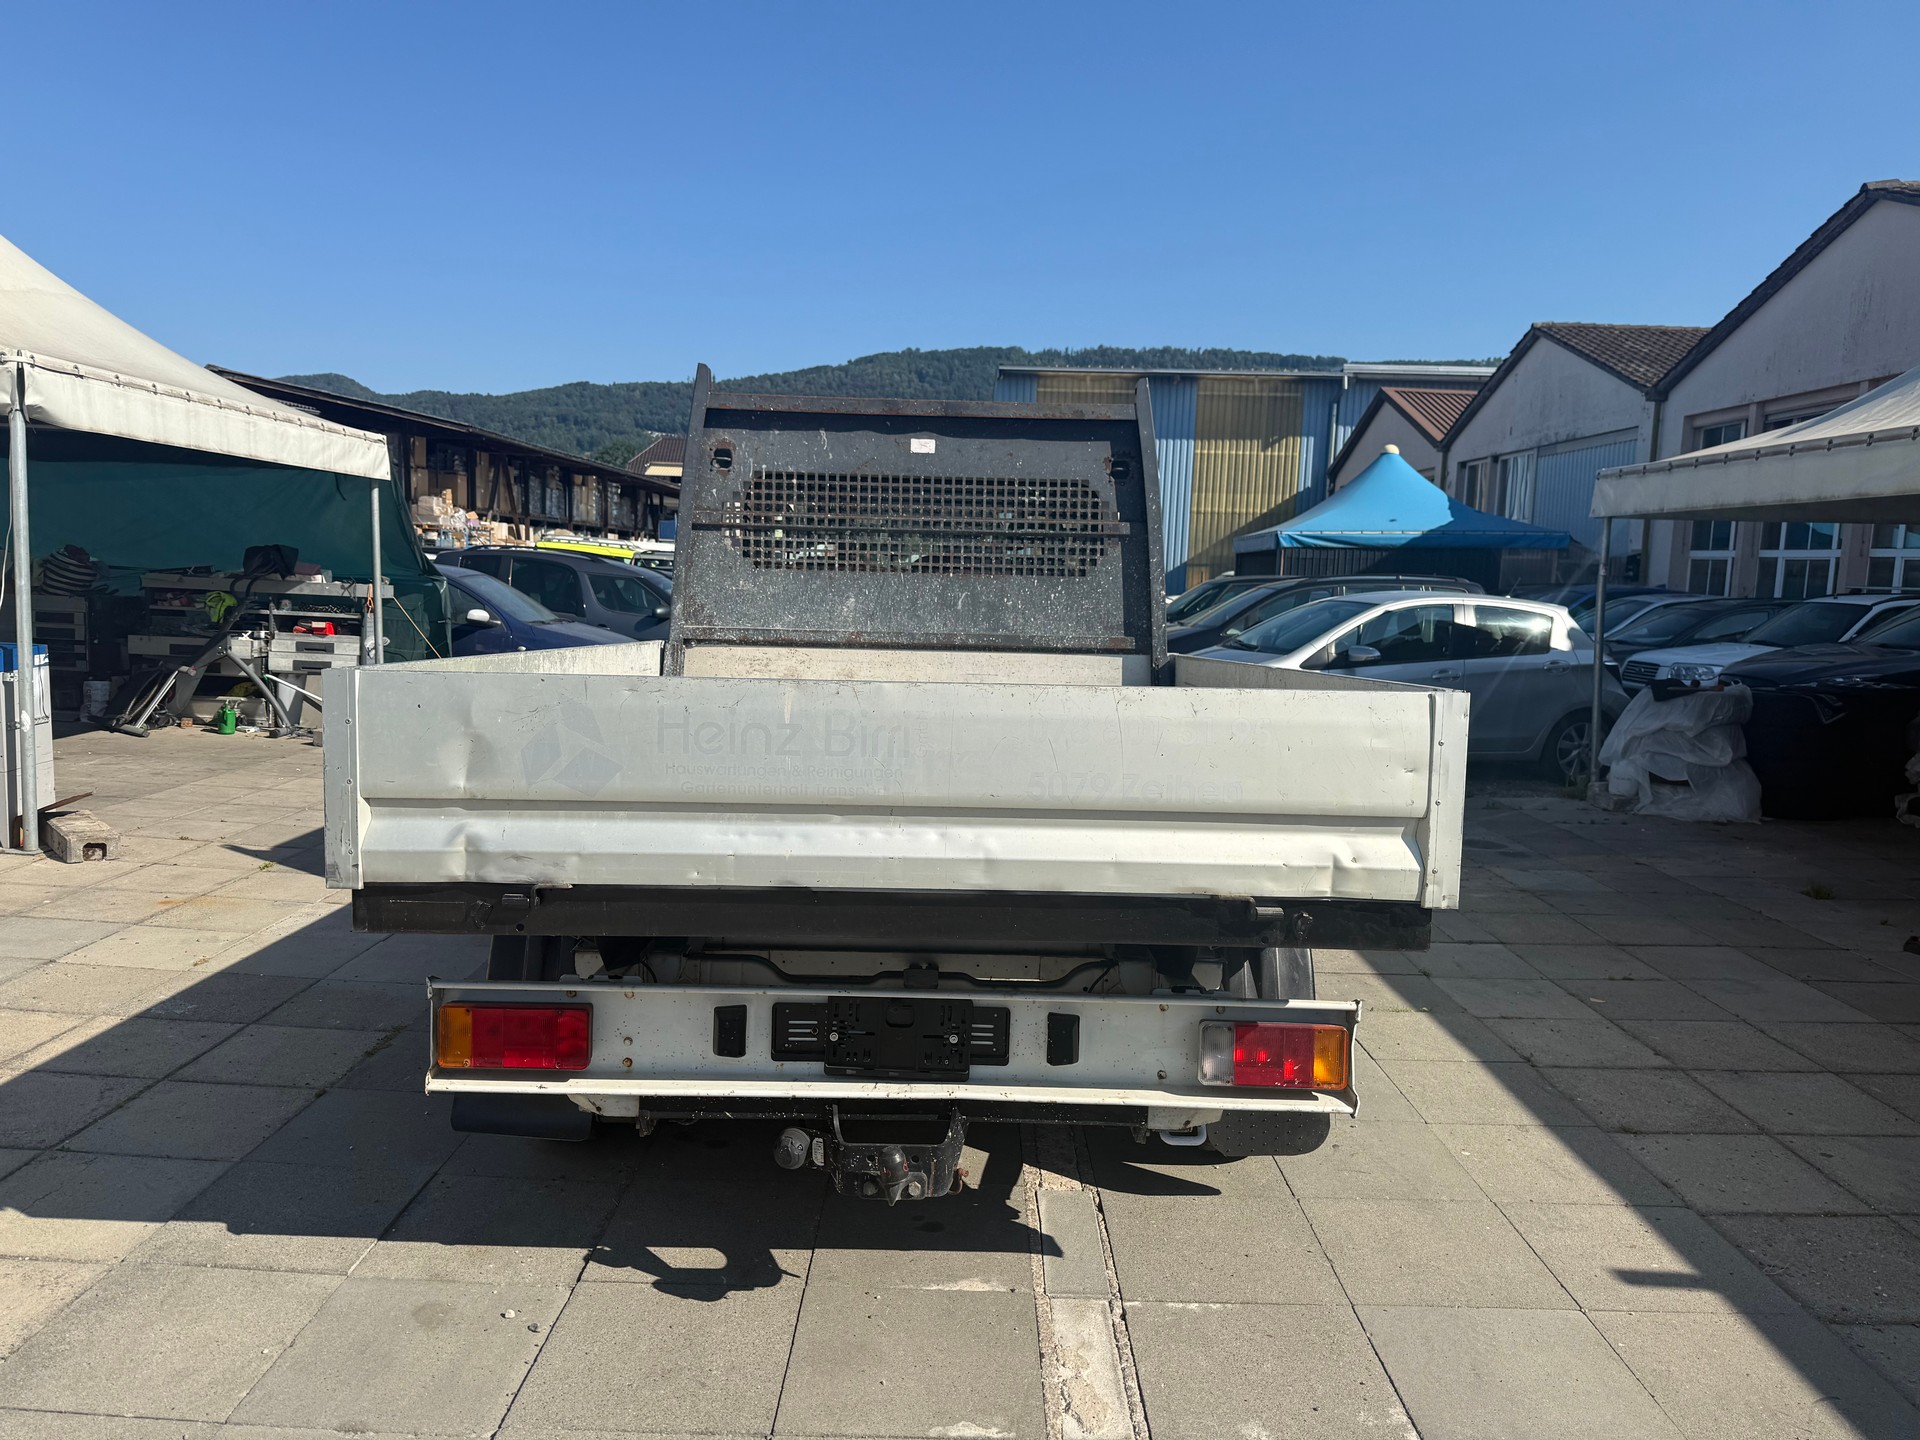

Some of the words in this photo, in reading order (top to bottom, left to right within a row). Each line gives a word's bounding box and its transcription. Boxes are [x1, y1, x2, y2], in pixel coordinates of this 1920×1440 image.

[656, 706, 803, 756] Heinz
[824, 708, 912, 759] Birri
[665, 762, 789, 779] Hauswartungen
[792, 764, 803, 777] &
[807, 764, 904, 782] Reinigungen
[680, 781, 809, 796] Gartenunterhalt
[1026, 771, 1112, 801] 5079
[1122, 772, 1244, 804] Zeihen
